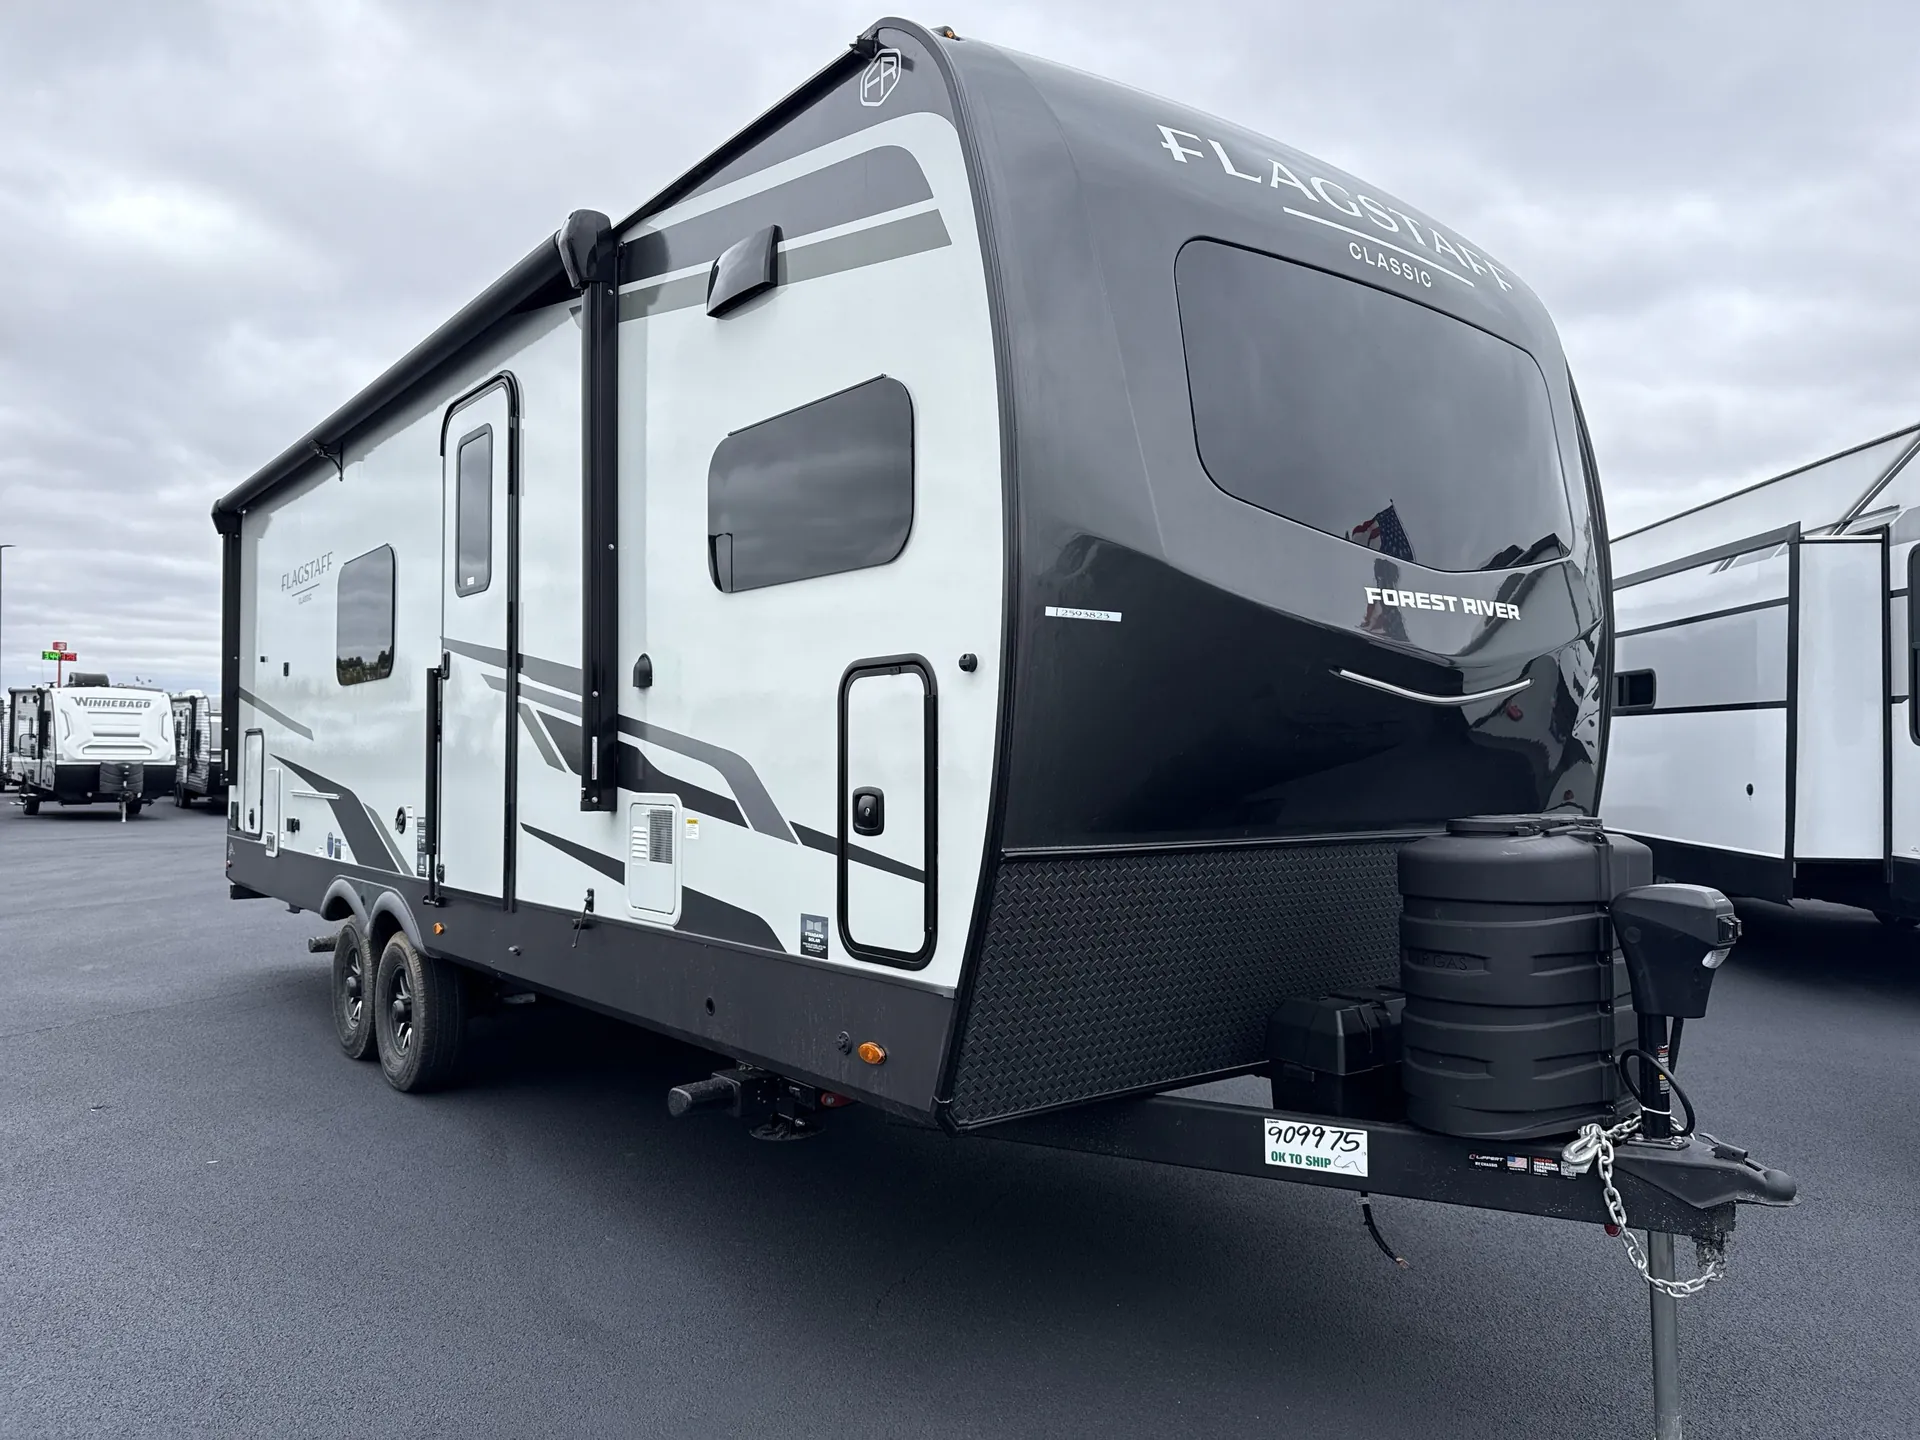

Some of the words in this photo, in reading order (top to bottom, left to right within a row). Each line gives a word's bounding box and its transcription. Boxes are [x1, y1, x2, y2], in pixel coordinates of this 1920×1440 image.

[1156, 123, 1513, 292] FLAGSTAFF
[1348, 241, 1433, 288] CLASSIC
[281, 551, 333, 592] FLAGSTAFF
[1364, 587, 1457, 612] FOREST
[1461, 597, 1521, 620] RIVER
[71, 697, 151, 708] WINNEBAGO
[1433, 954, 1468, 970] GAS
[1268, 1125, 1364, 1152] 909975
[1271, 1151, 1286, 1163] OK
[1289, 1153, 1302, 1164] TO
[1305, 1155, 1331, 1168] SHIP
